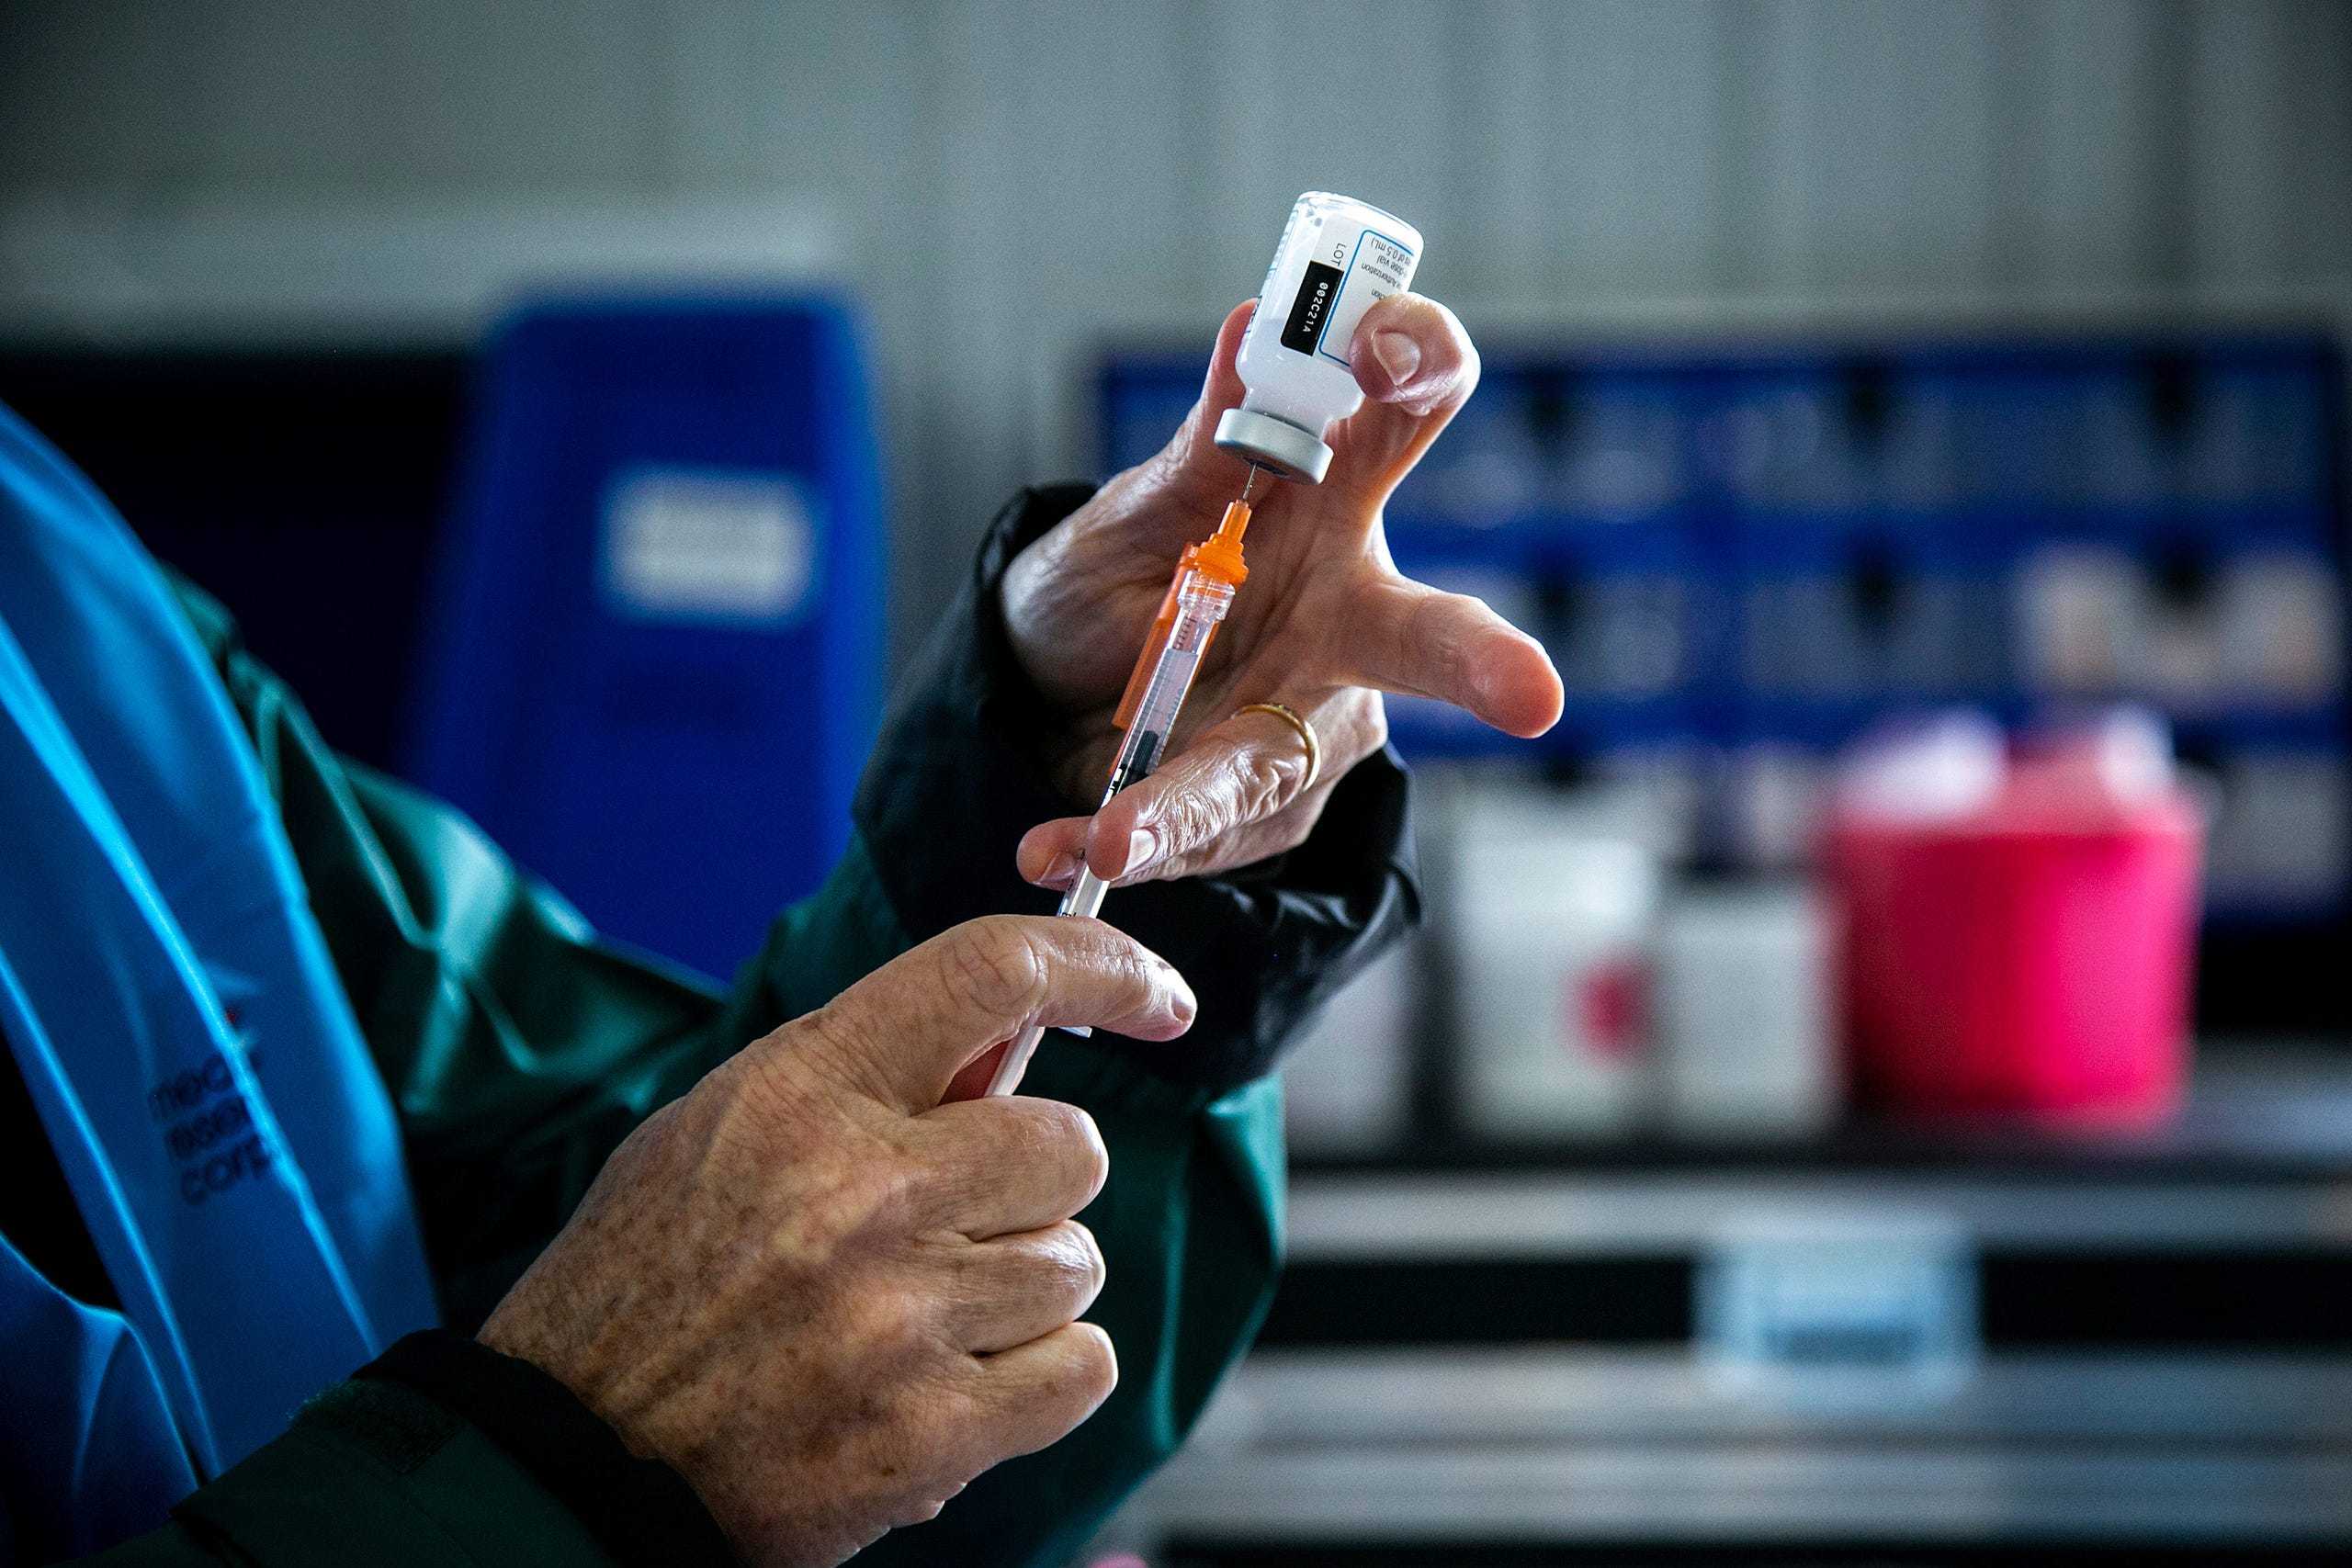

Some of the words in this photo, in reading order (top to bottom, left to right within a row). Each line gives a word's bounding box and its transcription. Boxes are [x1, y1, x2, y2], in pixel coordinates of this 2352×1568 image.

[1371, 237, 1386, 251] mL)
[1386, 246, 1398, 259] 0.5
[1331, 243, 1346, 266] LOT
[1376, 255, 1390, 266] vial
[1362, 264, 1396, 288] Authorization
[1302, 281, 1329, 333] 002C21A
